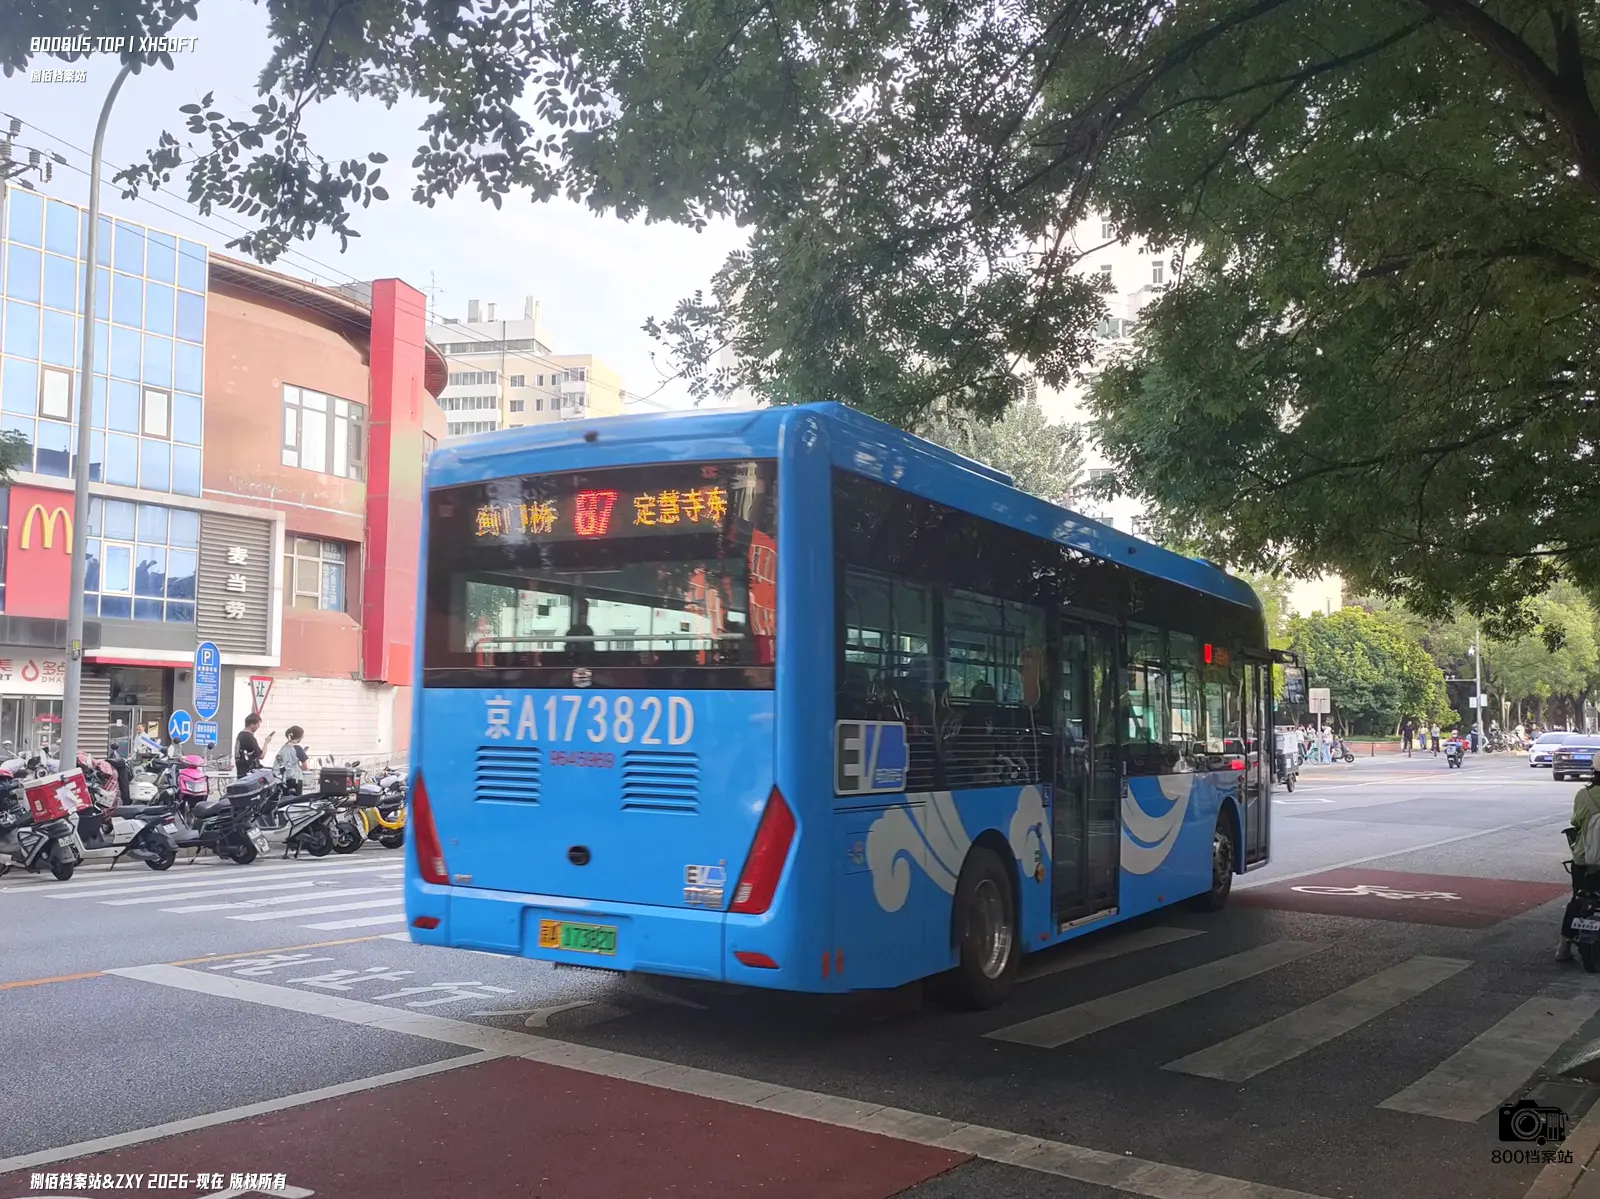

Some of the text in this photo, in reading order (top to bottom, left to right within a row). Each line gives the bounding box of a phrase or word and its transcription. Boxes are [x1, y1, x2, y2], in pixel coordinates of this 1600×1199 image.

[225, 546, 248, 620] 麦当劳
[41, 676, 65, 684] DMA
[256, 681, 265, 698] 让
[169, 719, 191, 736] 入口
[484, 694, 695, 746] 京A17382D
[207, 953, 595, 1028] 礼让行人
